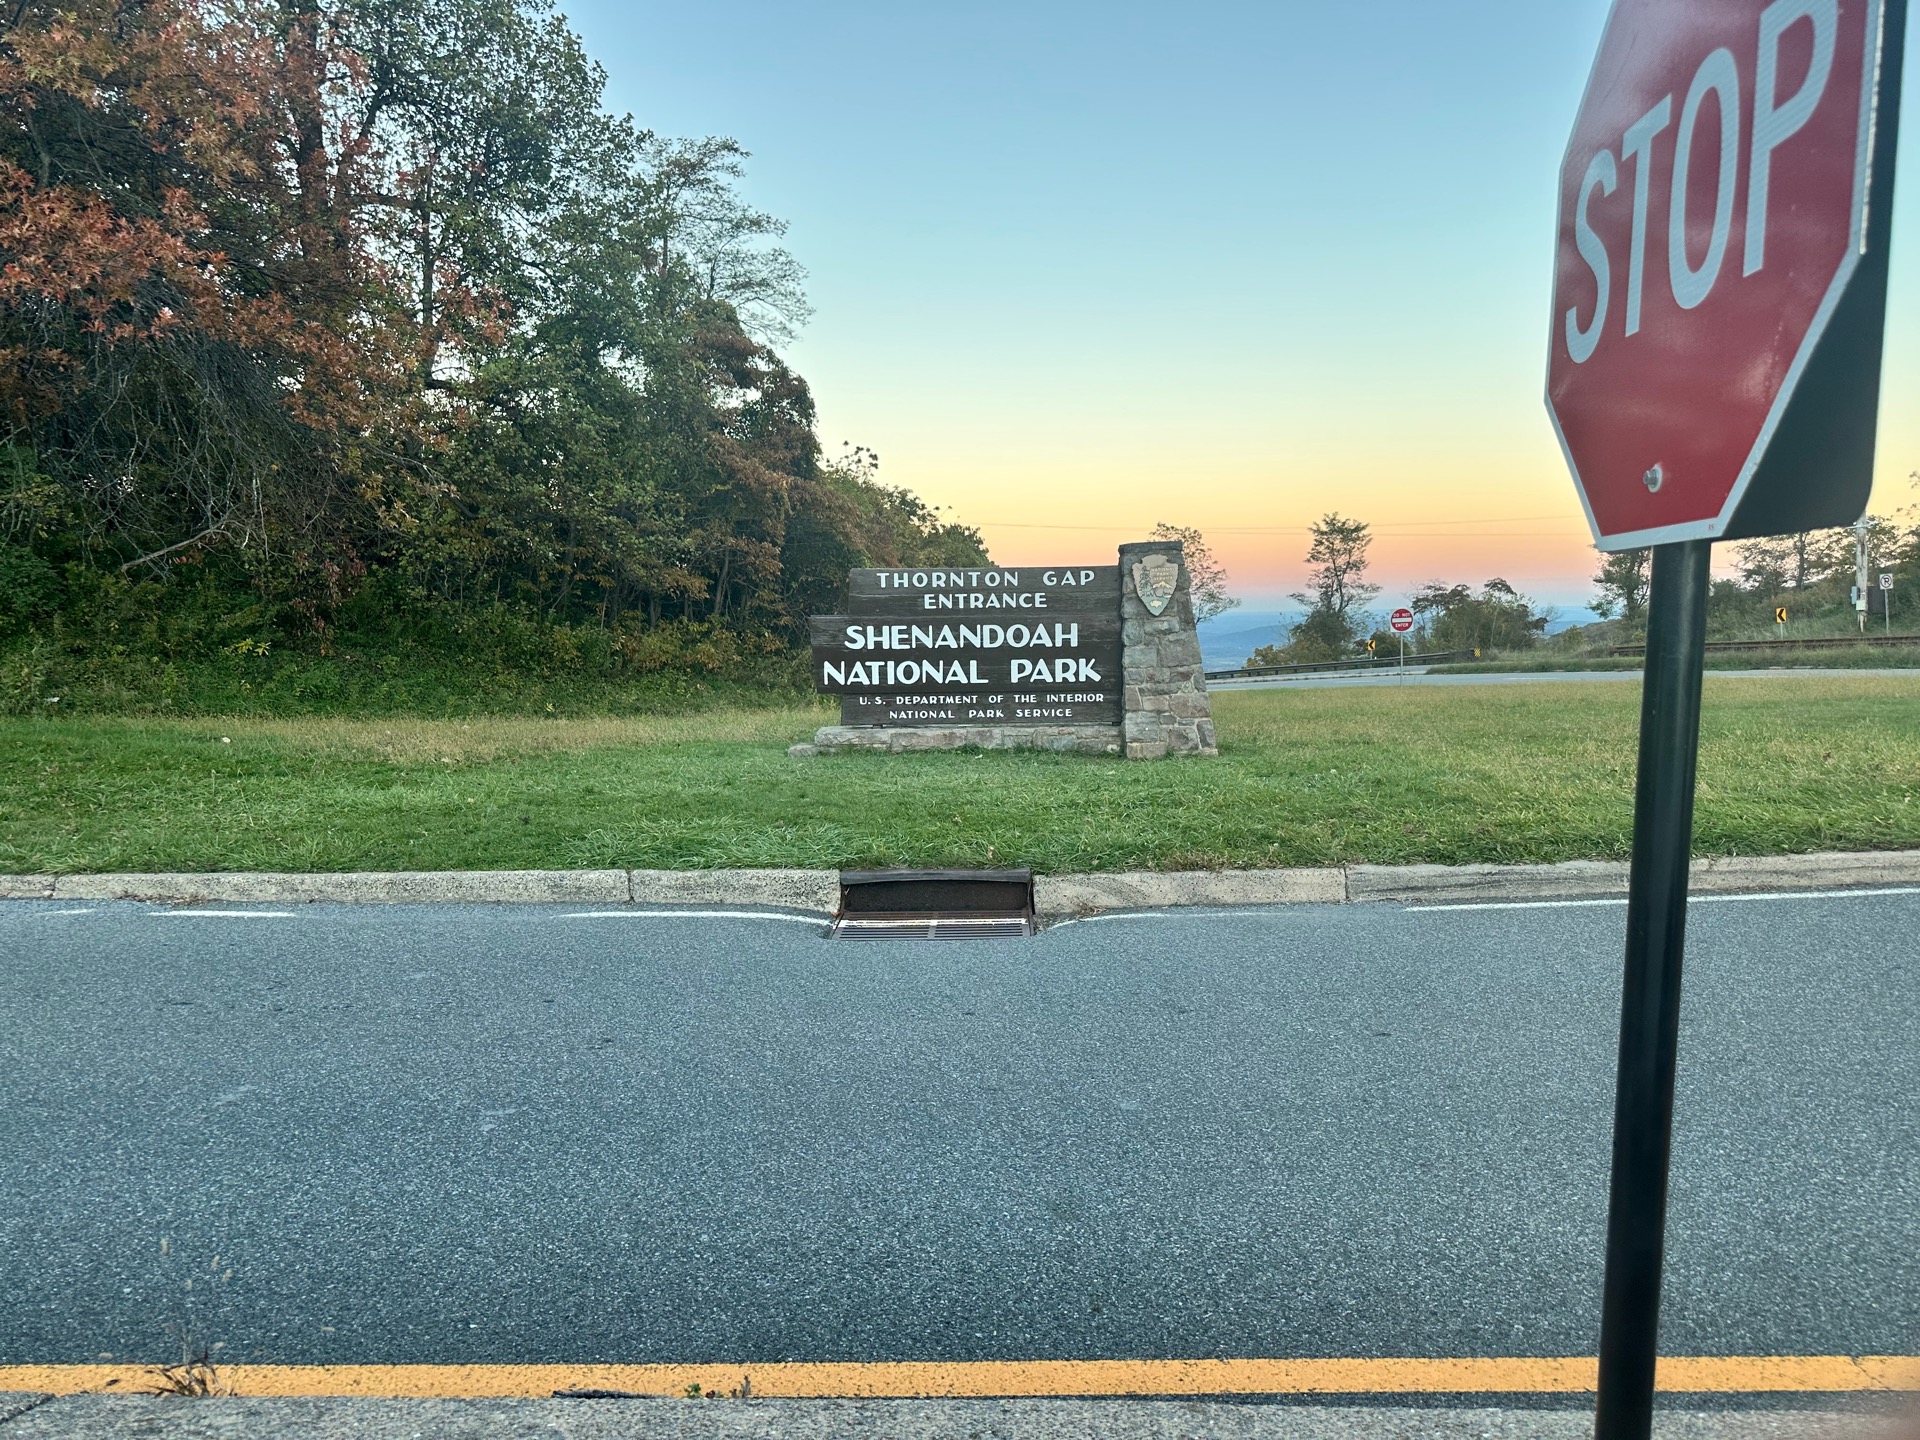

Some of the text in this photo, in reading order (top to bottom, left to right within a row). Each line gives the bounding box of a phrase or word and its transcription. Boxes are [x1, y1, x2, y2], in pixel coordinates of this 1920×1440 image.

[1565, 0, 1838, 364] STOP
[876, 570, 1095, 588] THORNTON GAP
[923, 592, 1048, 609] ENTRANCE
[845, 623, 1079, 650] SHENANDOAH
[823, 658, 1102, 686] NATIONAL PARK
[896, 695, 978, 705] DEPARTMENT
[988, 695, 1004, 703] OF
[1013, 694, 1037, 703] THE
[1046, 693, 1104, 703] INTERIOR
[889, 708, 1072, 719] NATIONAL PARK SERVICE
